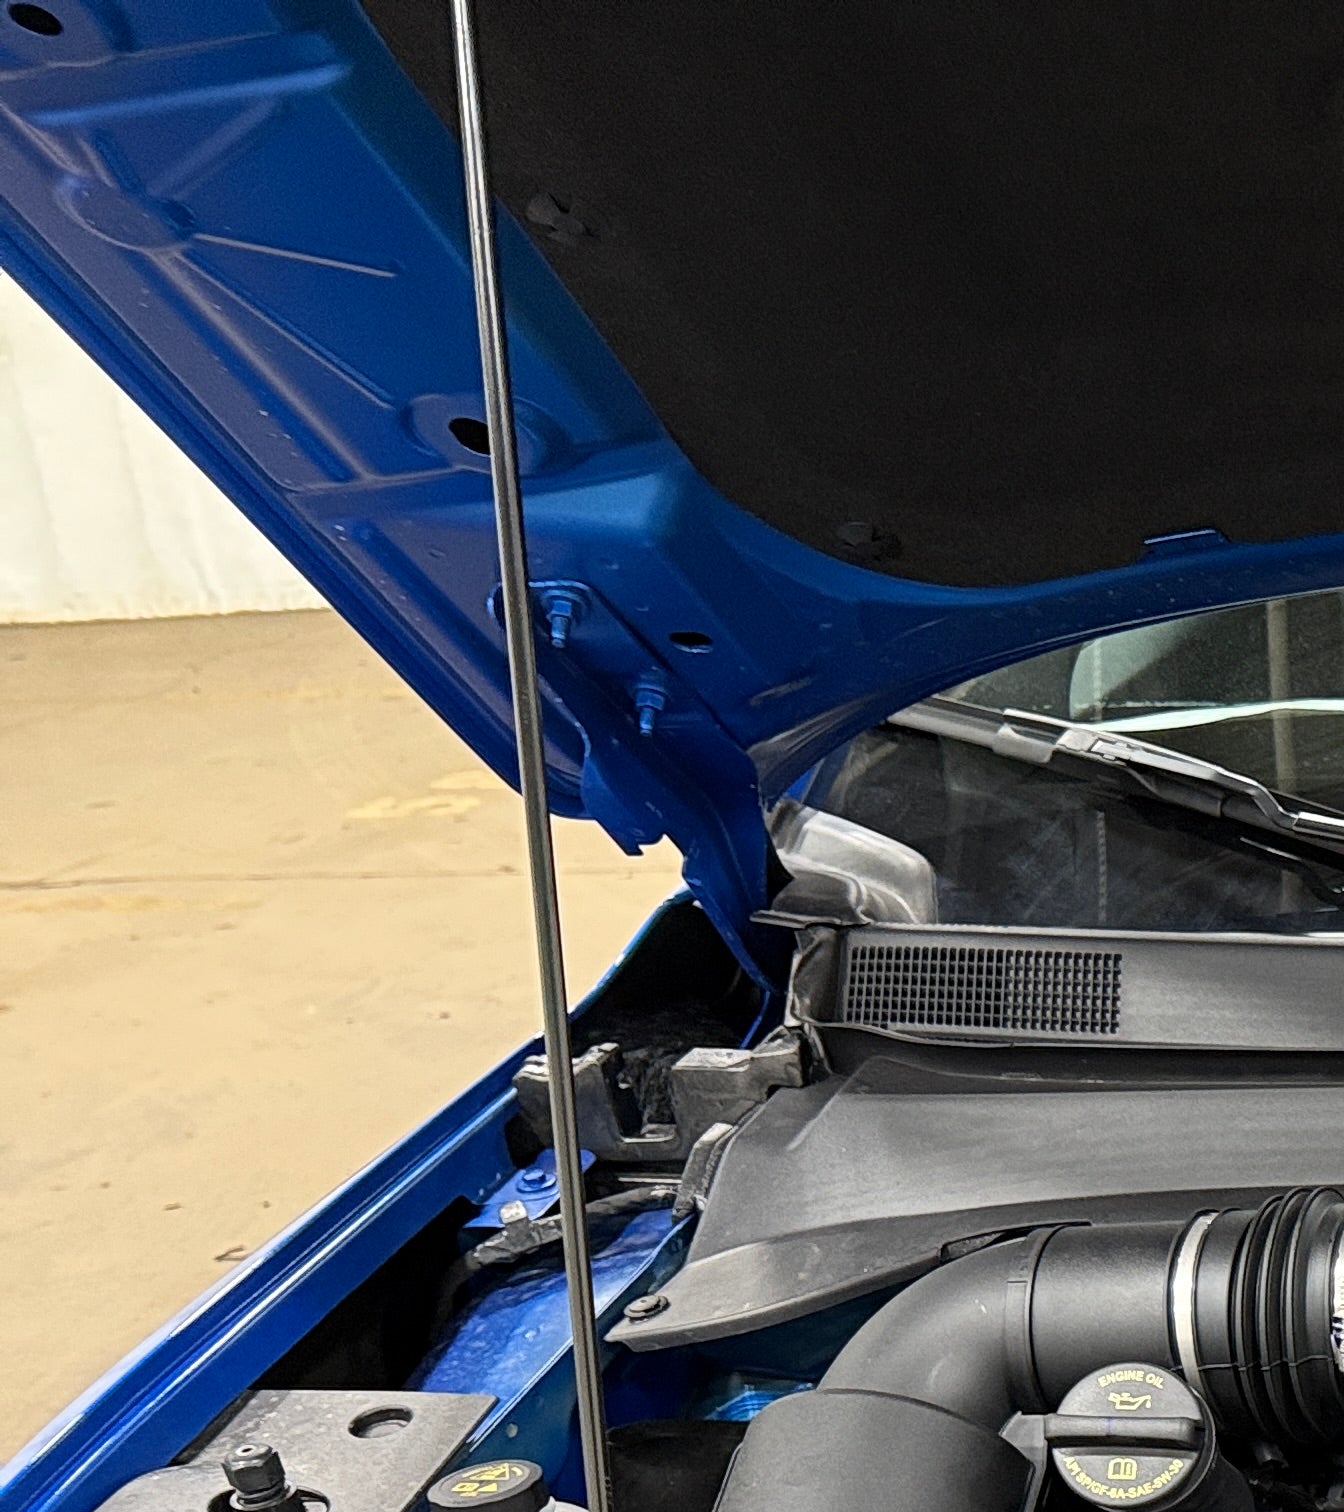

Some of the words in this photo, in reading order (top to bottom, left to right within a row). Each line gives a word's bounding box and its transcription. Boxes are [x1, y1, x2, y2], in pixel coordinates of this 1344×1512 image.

[1098, 1370, 1144, 1387] ENGINE
[1146, 1373, 1164, 1389] OIL
[1063, 1456, 1081, 1476] API
